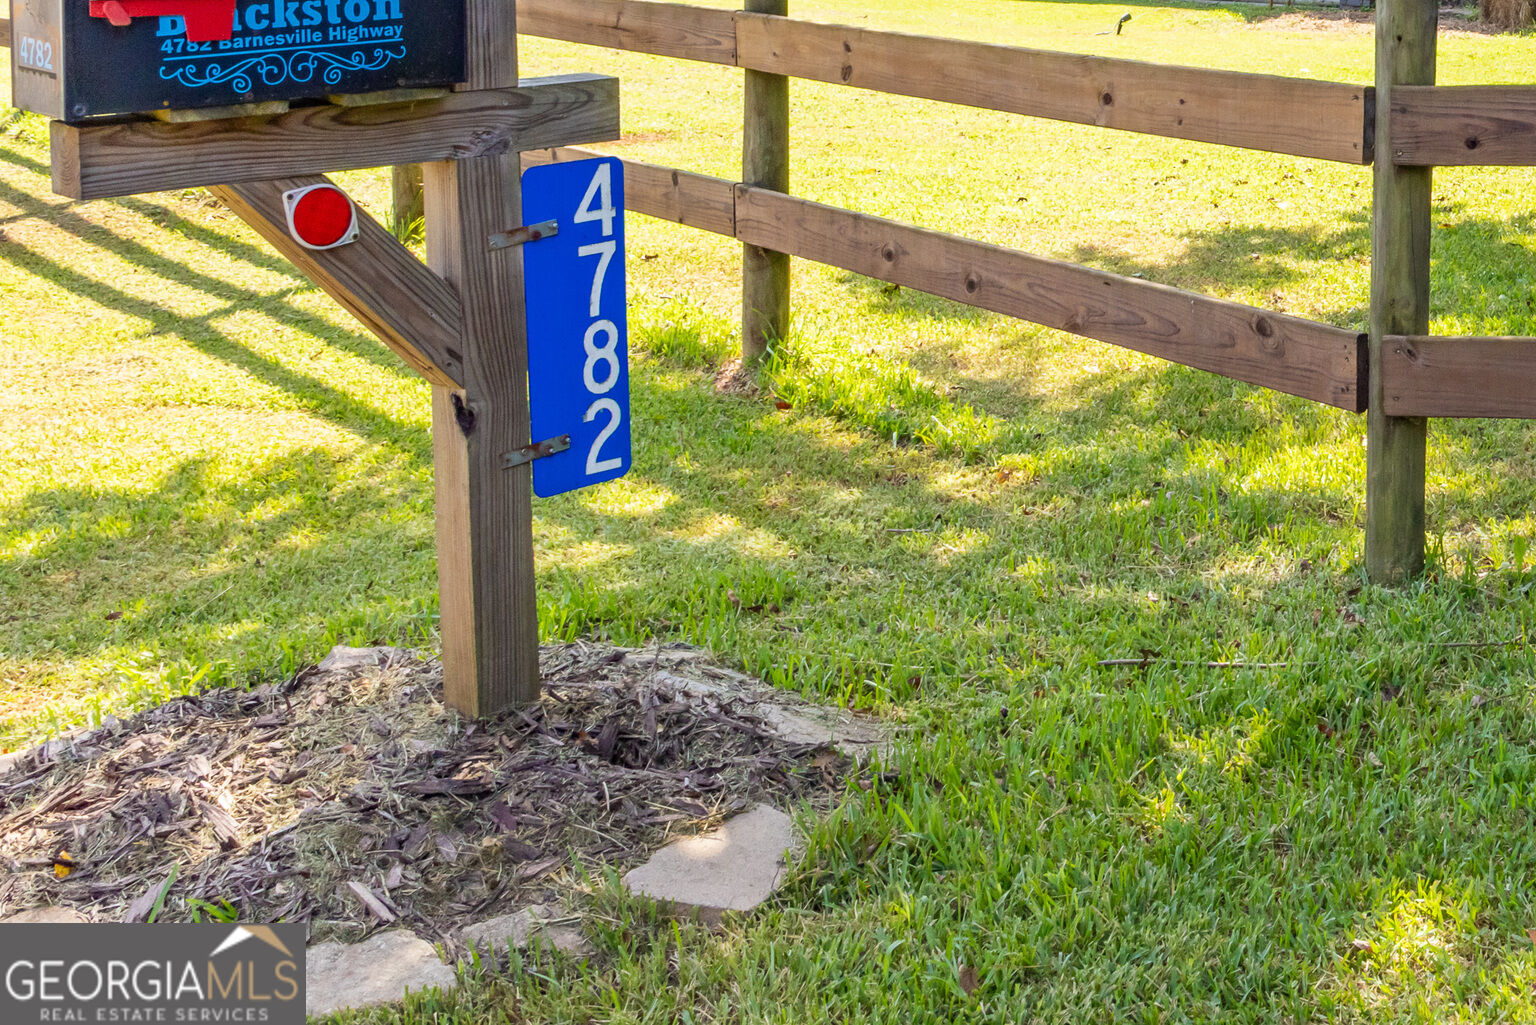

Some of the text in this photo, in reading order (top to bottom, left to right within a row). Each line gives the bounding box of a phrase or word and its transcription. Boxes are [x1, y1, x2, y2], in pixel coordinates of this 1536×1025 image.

[20, 36, 53, 70] 4782
[219, 29, 323, 50] Barnesville
[329, 25, 403, 43] Highway
[574, 163, 623, 475] 4782
